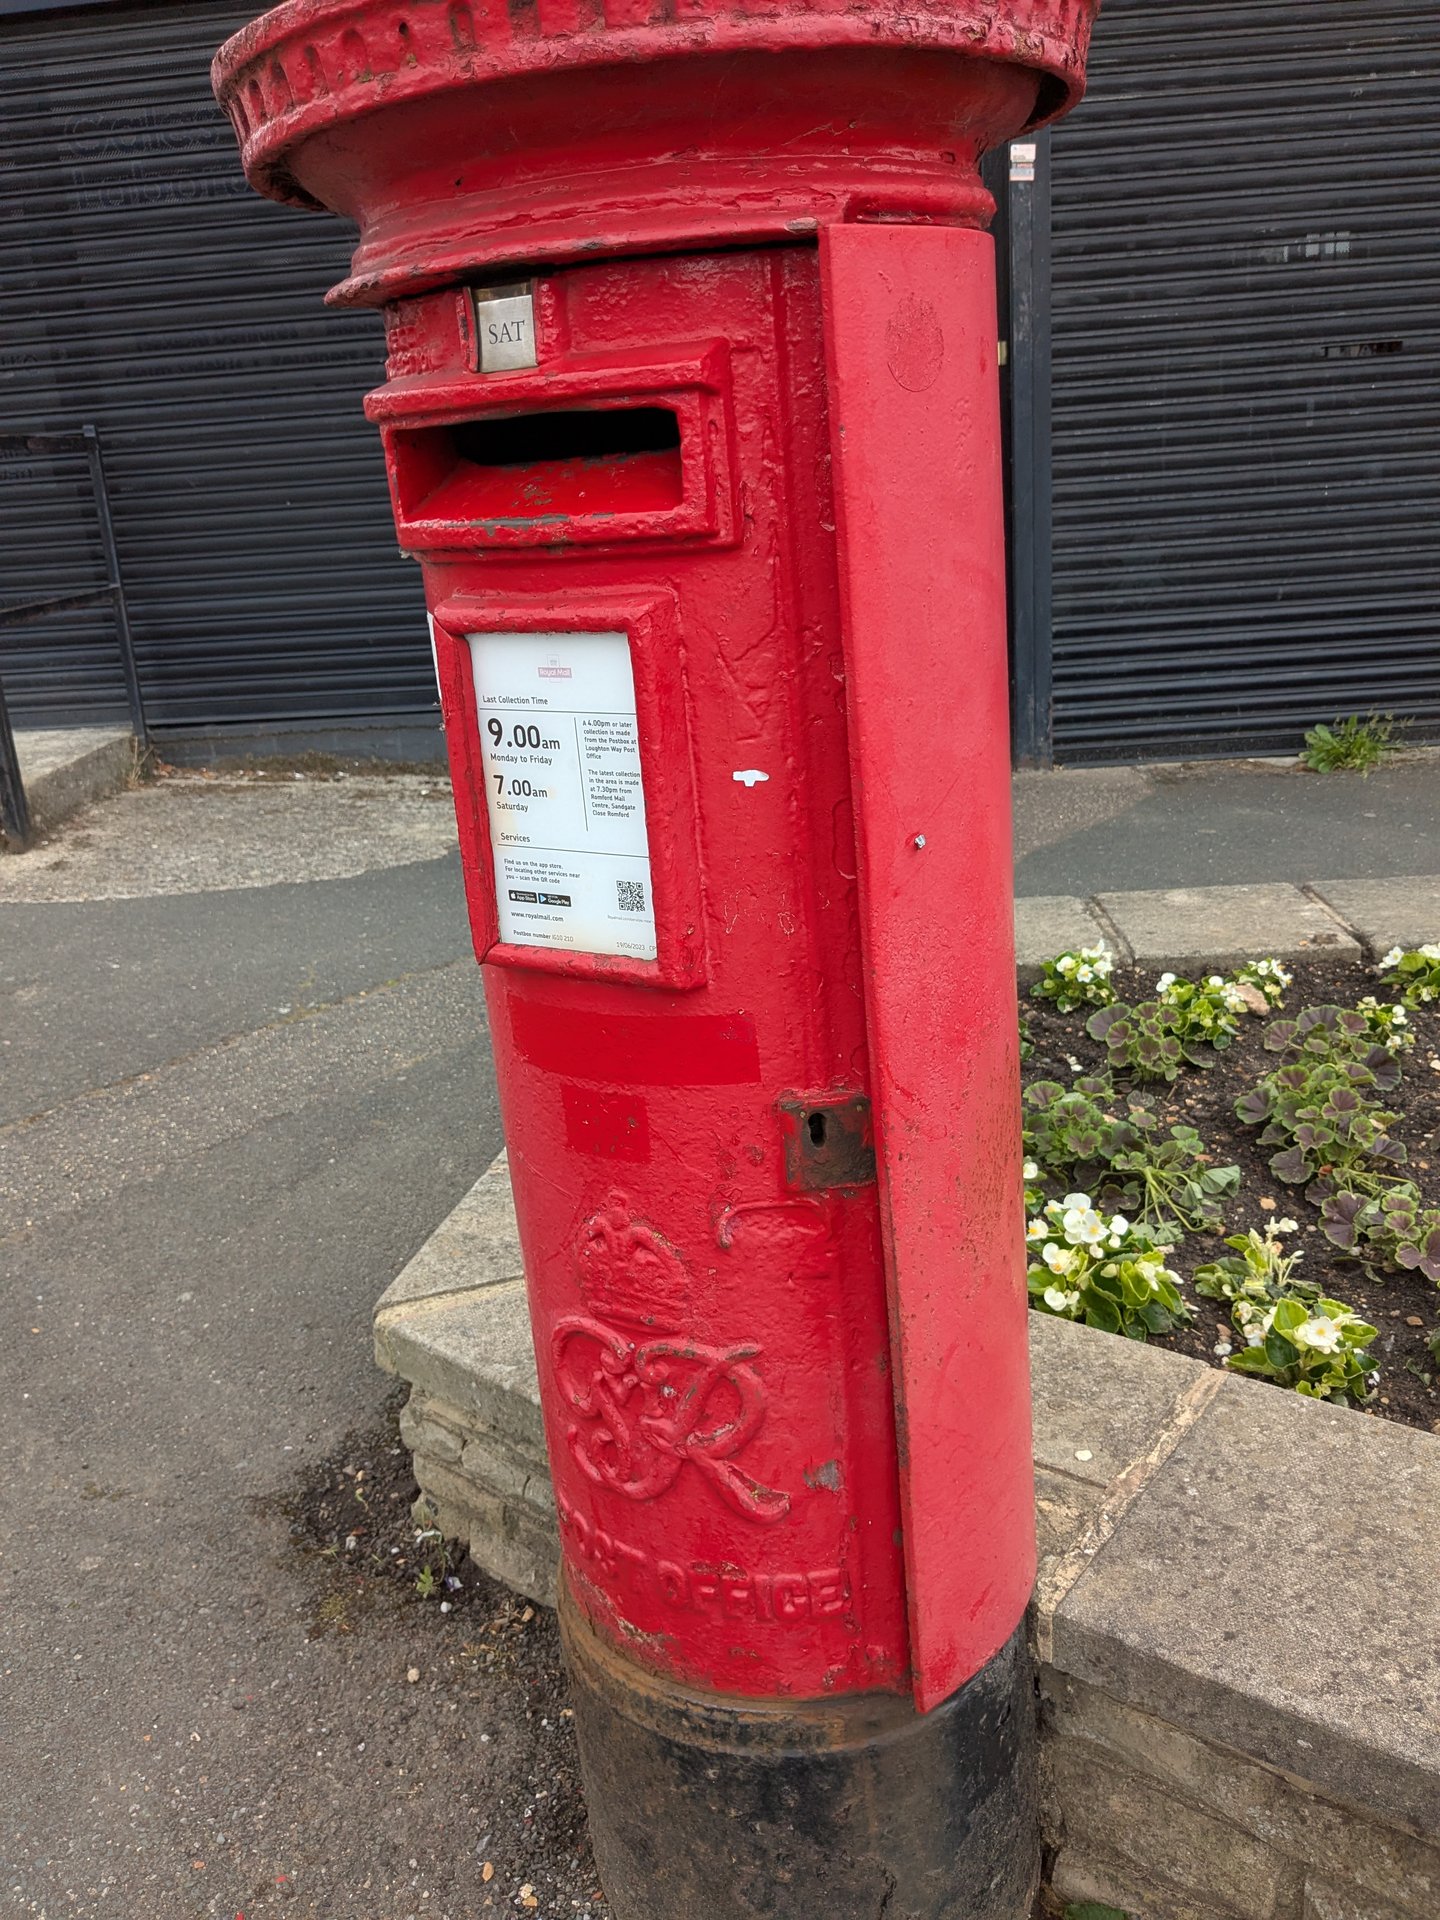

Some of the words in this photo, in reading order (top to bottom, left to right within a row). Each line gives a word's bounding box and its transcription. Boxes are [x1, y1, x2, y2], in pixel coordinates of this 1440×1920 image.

[488, 320, 525, 345] SAT
[539, 668, 556, 677] Royal
[482, 695, 497, 704] Last
[499, 696, 530, 704] Collection
[531, 697, 548, 705] Time
[587, 720, 611, 728] 4.00pm
[487, 717, 561, 750] 9.00am
[490, 753, 518, 764] Monday
[520, 755, 528, 763] to
[530, 755, 552, 766] Friday
[599, 769, 614, 777] latest
[493, 774, 548, 798] 7.00am
[596, 786, 618, 794] 7.30pm
[496, 801, 529, 812] Saturday
[611, 803, 636, 811] Sandgate
[607, 810, 630, 818] Romford
[500, 832, 531, 843] Services
[514, 867, 533, 875] locating
[510, 911, 564, 922] www.royalmail.com
[513, 929, 532, 937] Postbox
[532, 932, 551, 940] number
[616, 941, 645, 951] 19/06/2023
[657, 1560, 847, 1621] OFFICE
